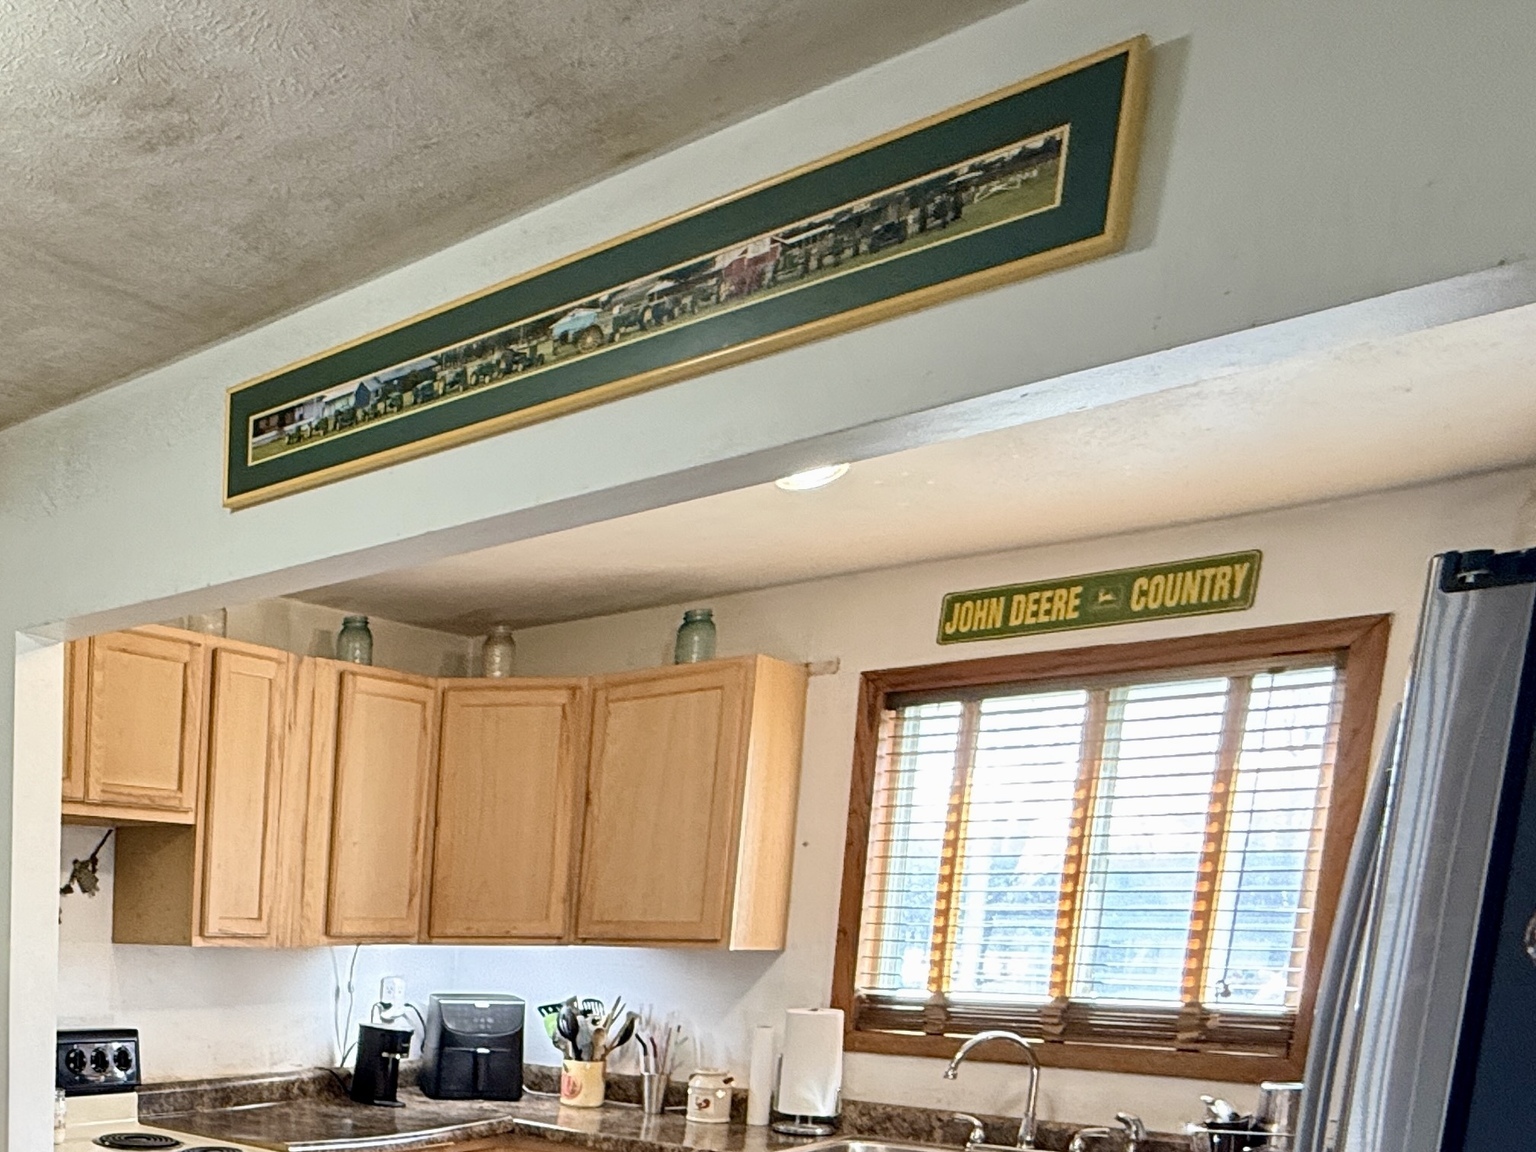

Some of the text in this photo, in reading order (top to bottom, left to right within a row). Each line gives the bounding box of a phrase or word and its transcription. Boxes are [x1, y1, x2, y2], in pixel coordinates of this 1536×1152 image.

[945, 562, 1251, 636] JOHN DEERE COUNTRY
